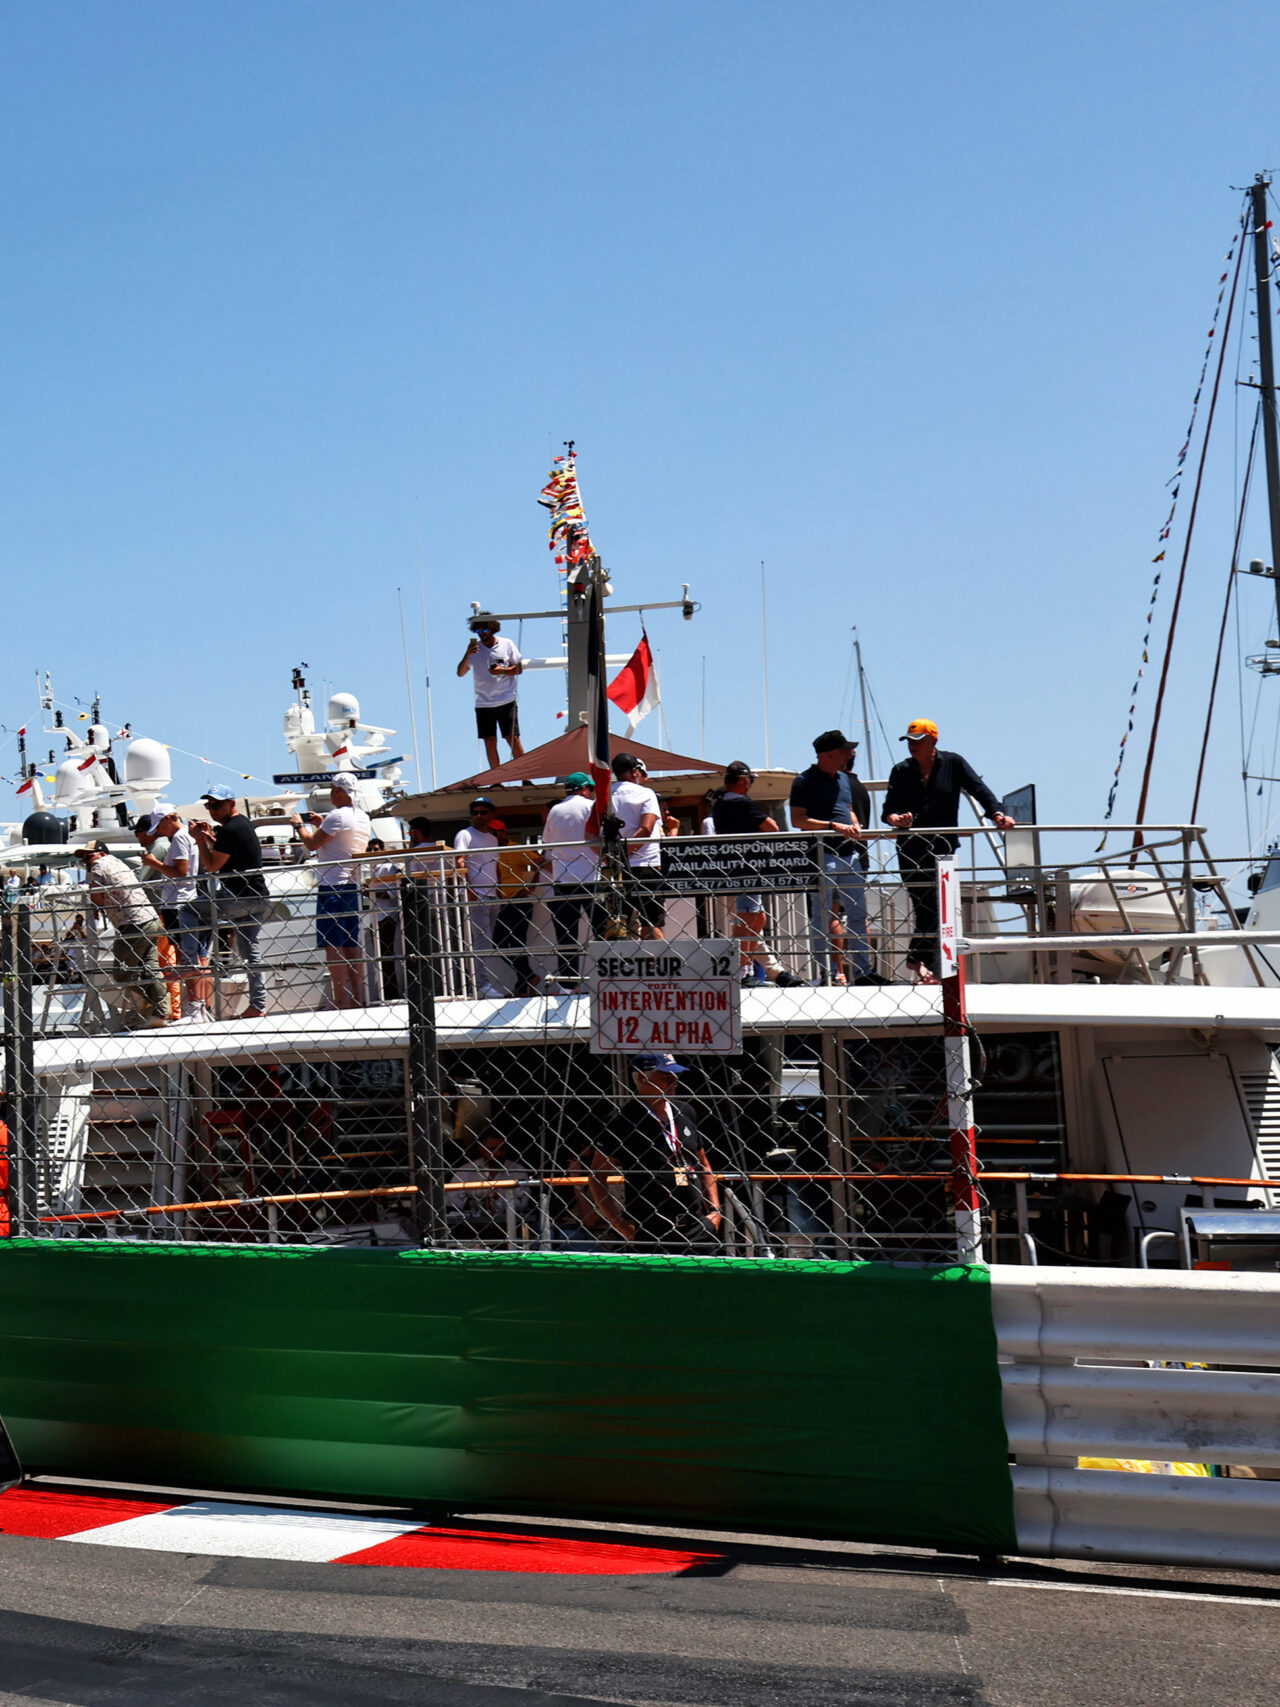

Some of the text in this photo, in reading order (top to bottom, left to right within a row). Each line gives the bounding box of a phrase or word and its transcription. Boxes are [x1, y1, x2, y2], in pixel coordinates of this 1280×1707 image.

[668, 840, 809, 857] PLACES DISPONIBLES
[668, 856, 810, 872] AVAILABILITY ON BOARD
[669, 880, 691, 890] TEL
[743, 878, 757, 887] 07
[796, 874, 811, 885] 87
[942, 926, 953, 938] FIRE
[597, 956, 731, 977] SECTEUR 12
[602, 991, 728, 1012] INTERVENTION
[617, 1016, 714, 1045] 12 ALPHA
